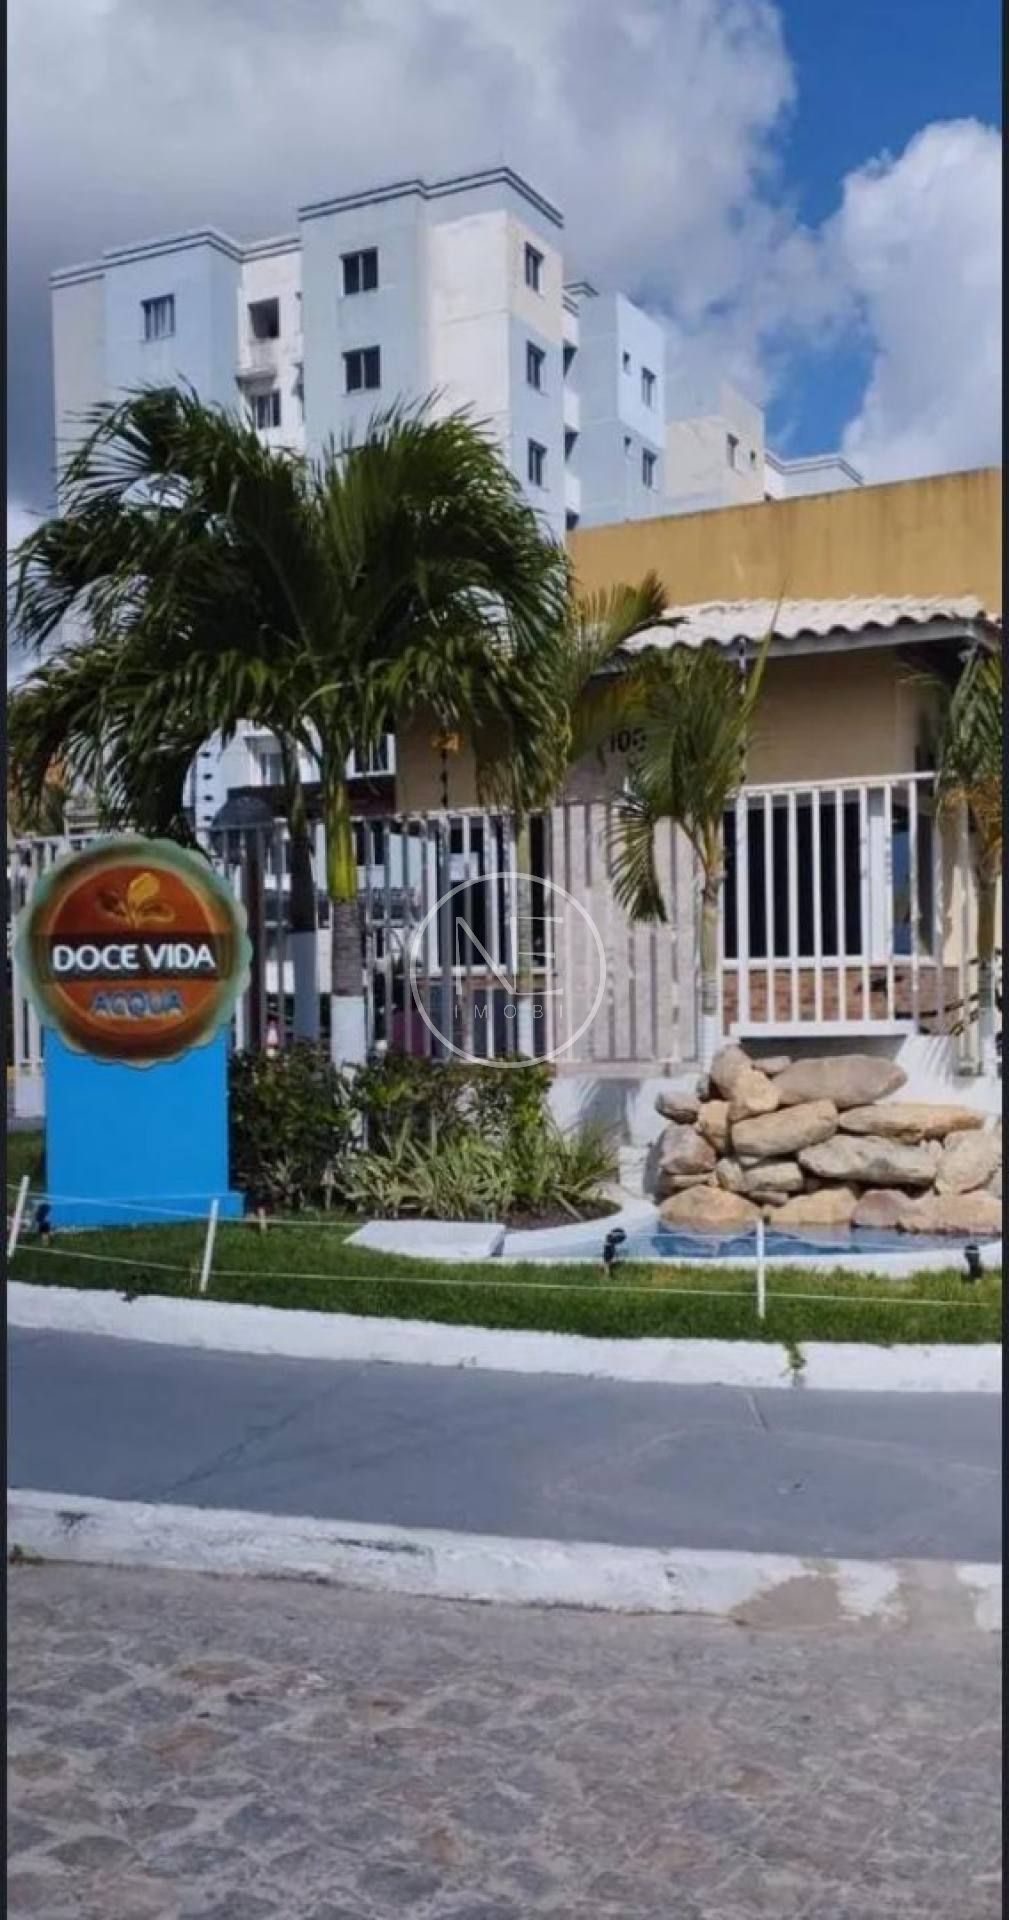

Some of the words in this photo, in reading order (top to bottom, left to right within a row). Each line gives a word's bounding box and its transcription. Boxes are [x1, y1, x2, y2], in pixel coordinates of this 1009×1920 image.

[53, 945, 140, 971] DOCE
[144, 944, 216, 969] VIDA
[92, 989, 183, 1018] ACQUA
